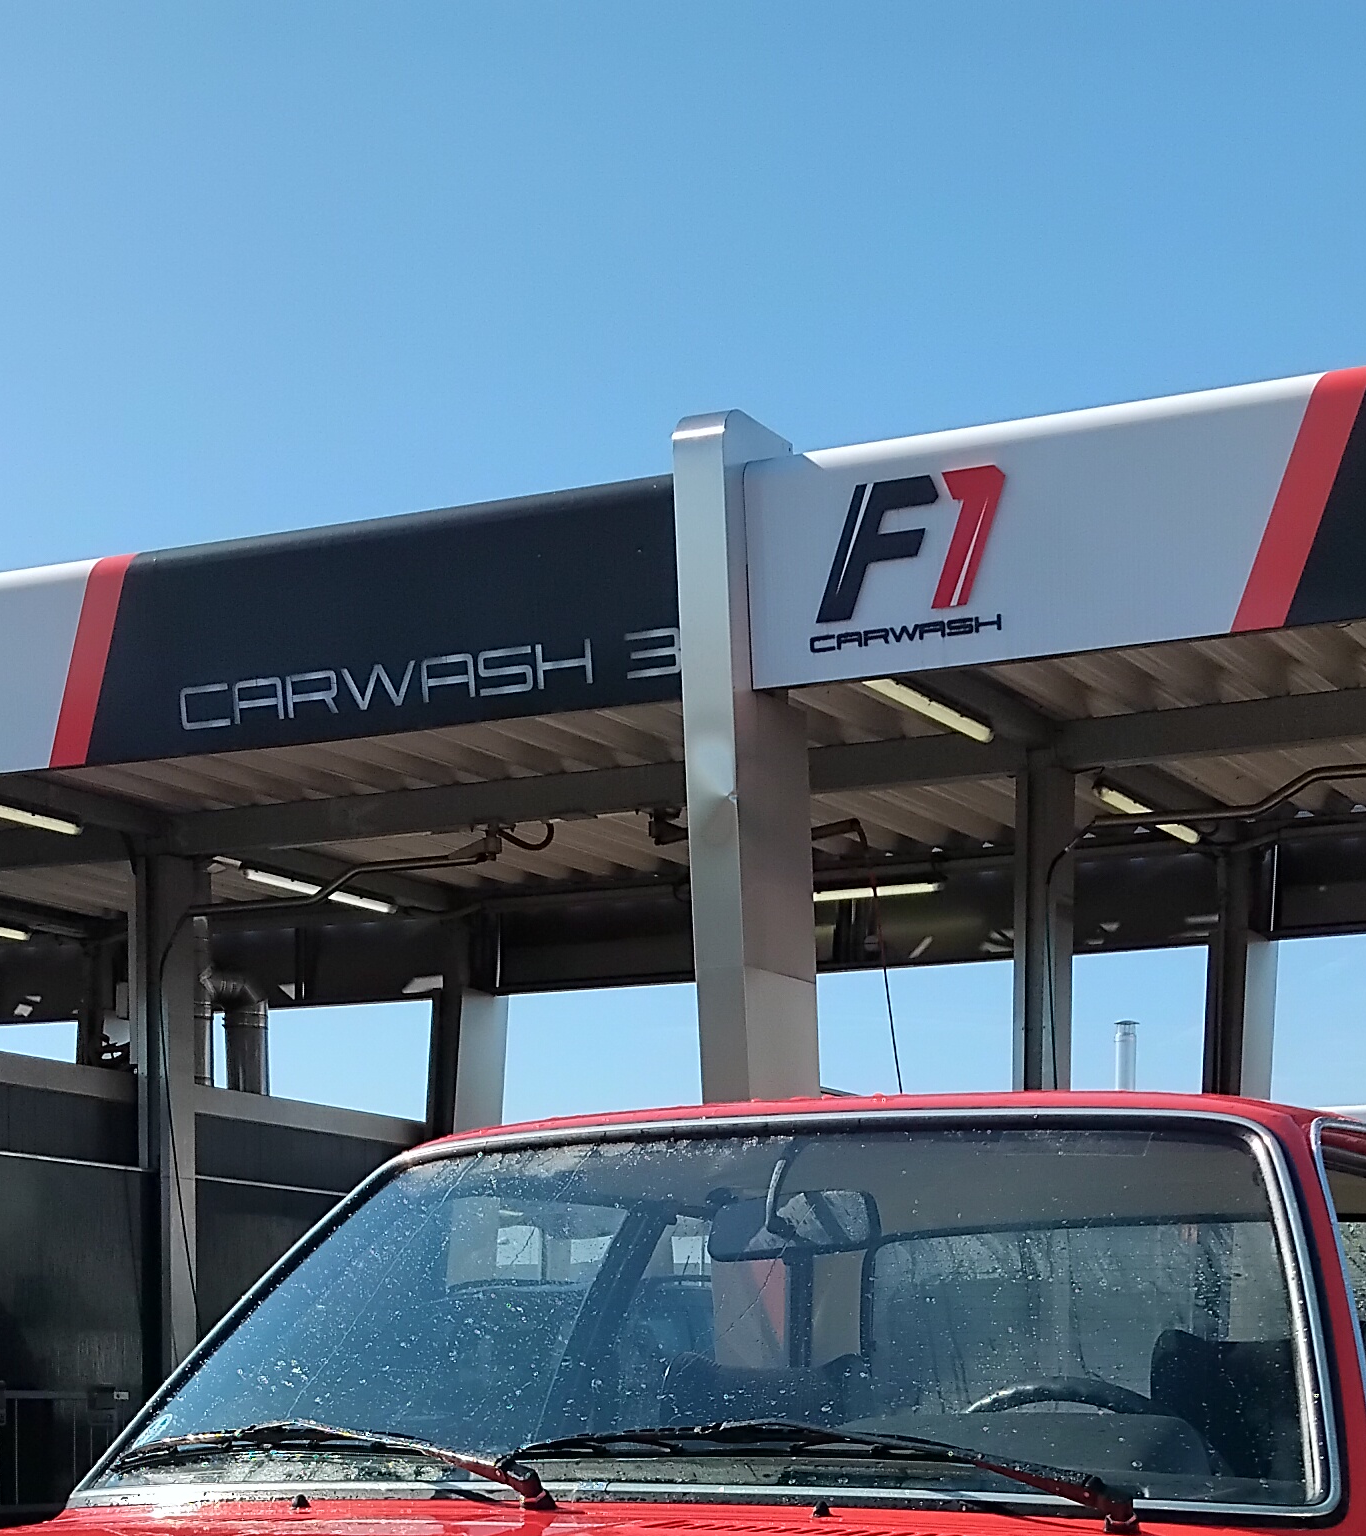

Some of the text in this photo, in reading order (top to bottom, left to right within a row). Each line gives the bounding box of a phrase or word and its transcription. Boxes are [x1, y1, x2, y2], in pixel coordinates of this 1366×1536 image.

[816, 465, 1006, 623] F1
[180, 627, 681, 730] CARWASH 3
[810, 614, 1002, 653] CARWASH
